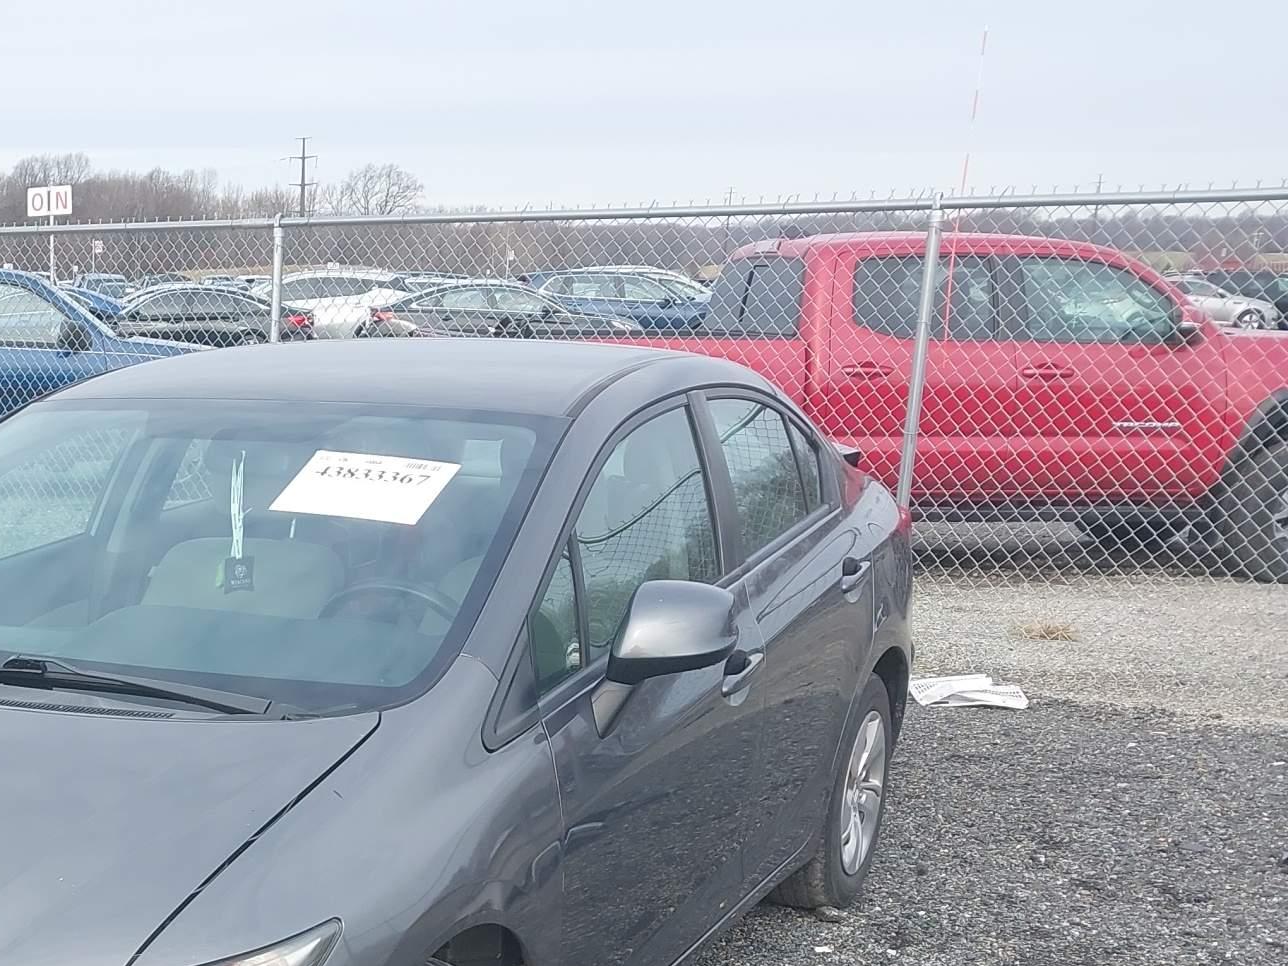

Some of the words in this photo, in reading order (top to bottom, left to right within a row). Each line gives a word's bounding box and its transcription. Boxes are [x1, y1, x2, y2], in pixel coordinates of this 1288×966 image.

[32, 193, 43, 211] O
[55, 191, 67, 210] N
[315, 466, 431, 486] 43833367
